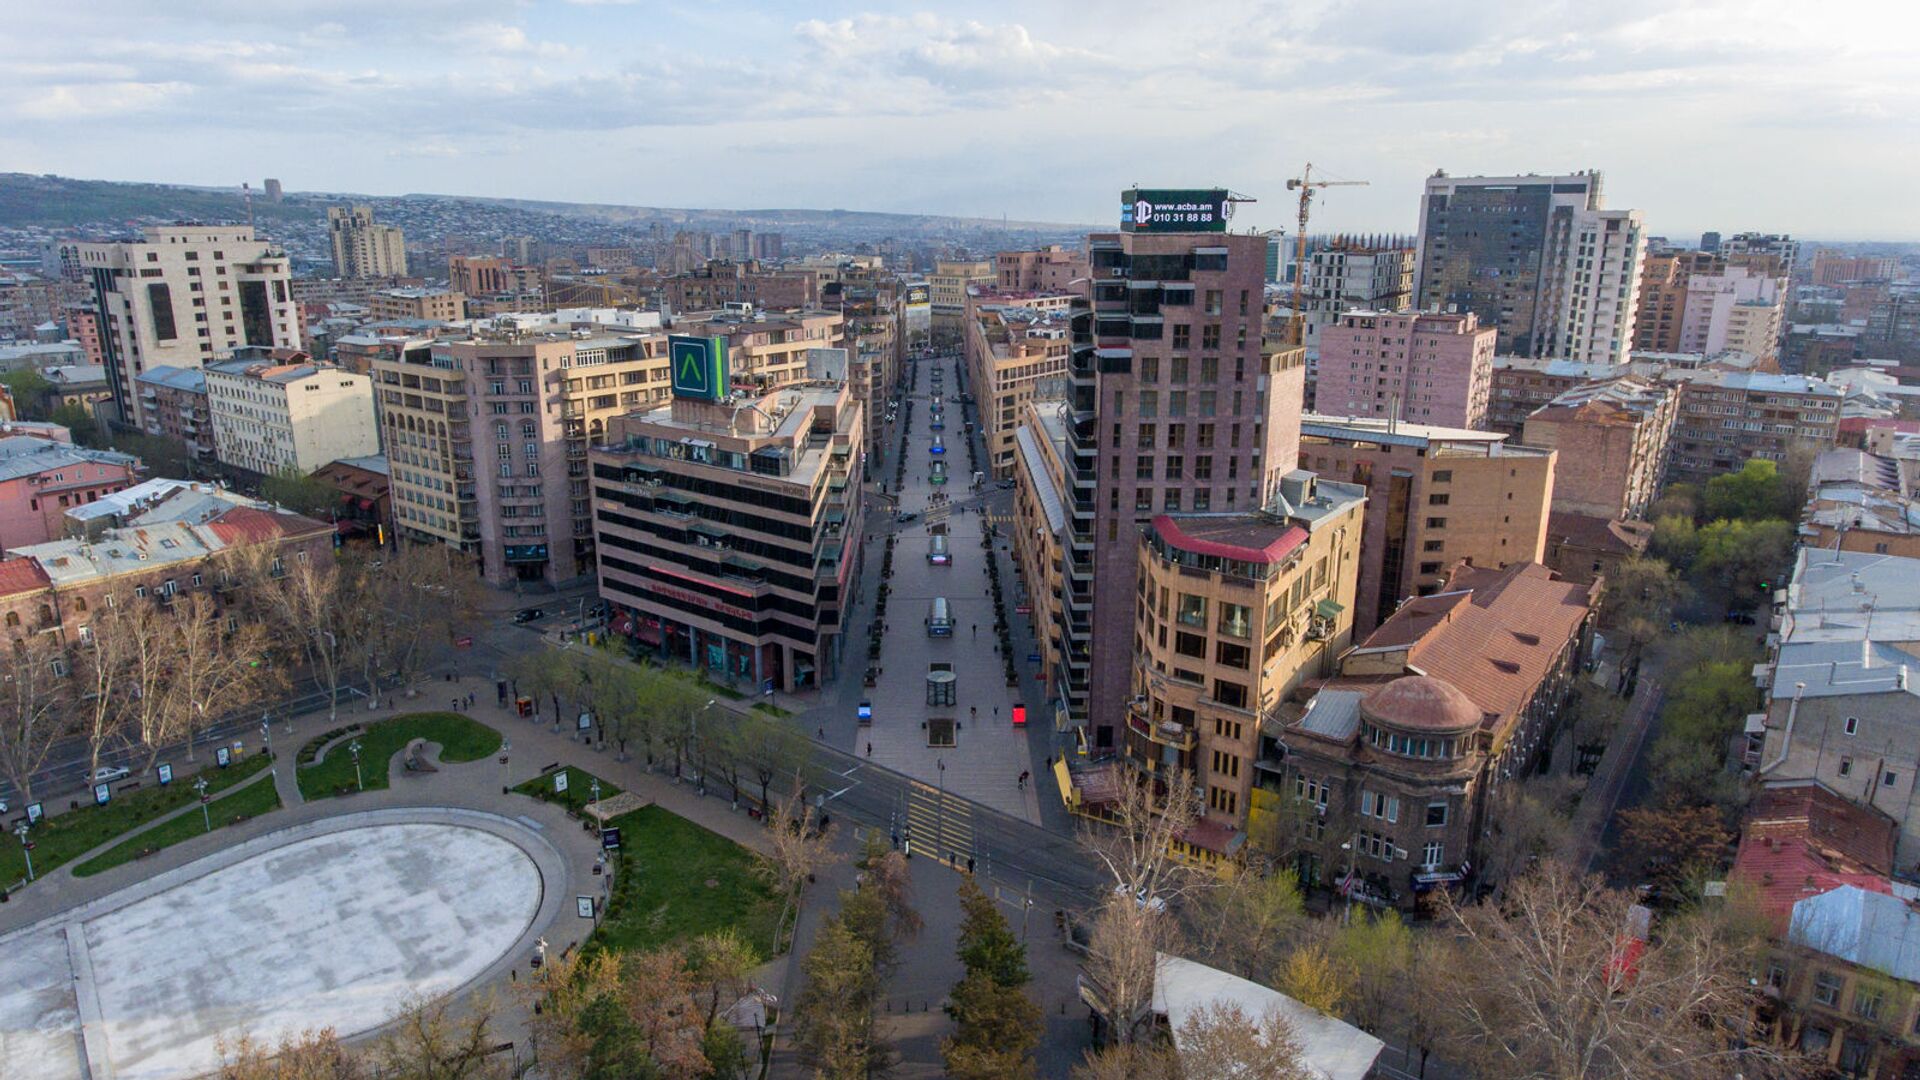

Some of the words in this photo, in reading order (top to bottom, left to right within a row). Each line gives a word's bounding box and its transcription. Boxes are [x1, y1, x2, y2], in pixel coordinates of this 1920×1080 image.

[1155, 203, 1212, 211] www.acba.am
[1153, 213, 1171, 222] 010
[1173, 213, 1184, 222] 31
[1187, 213, 1198, 222] 88
[1201, 213, 1212, 222] 88
